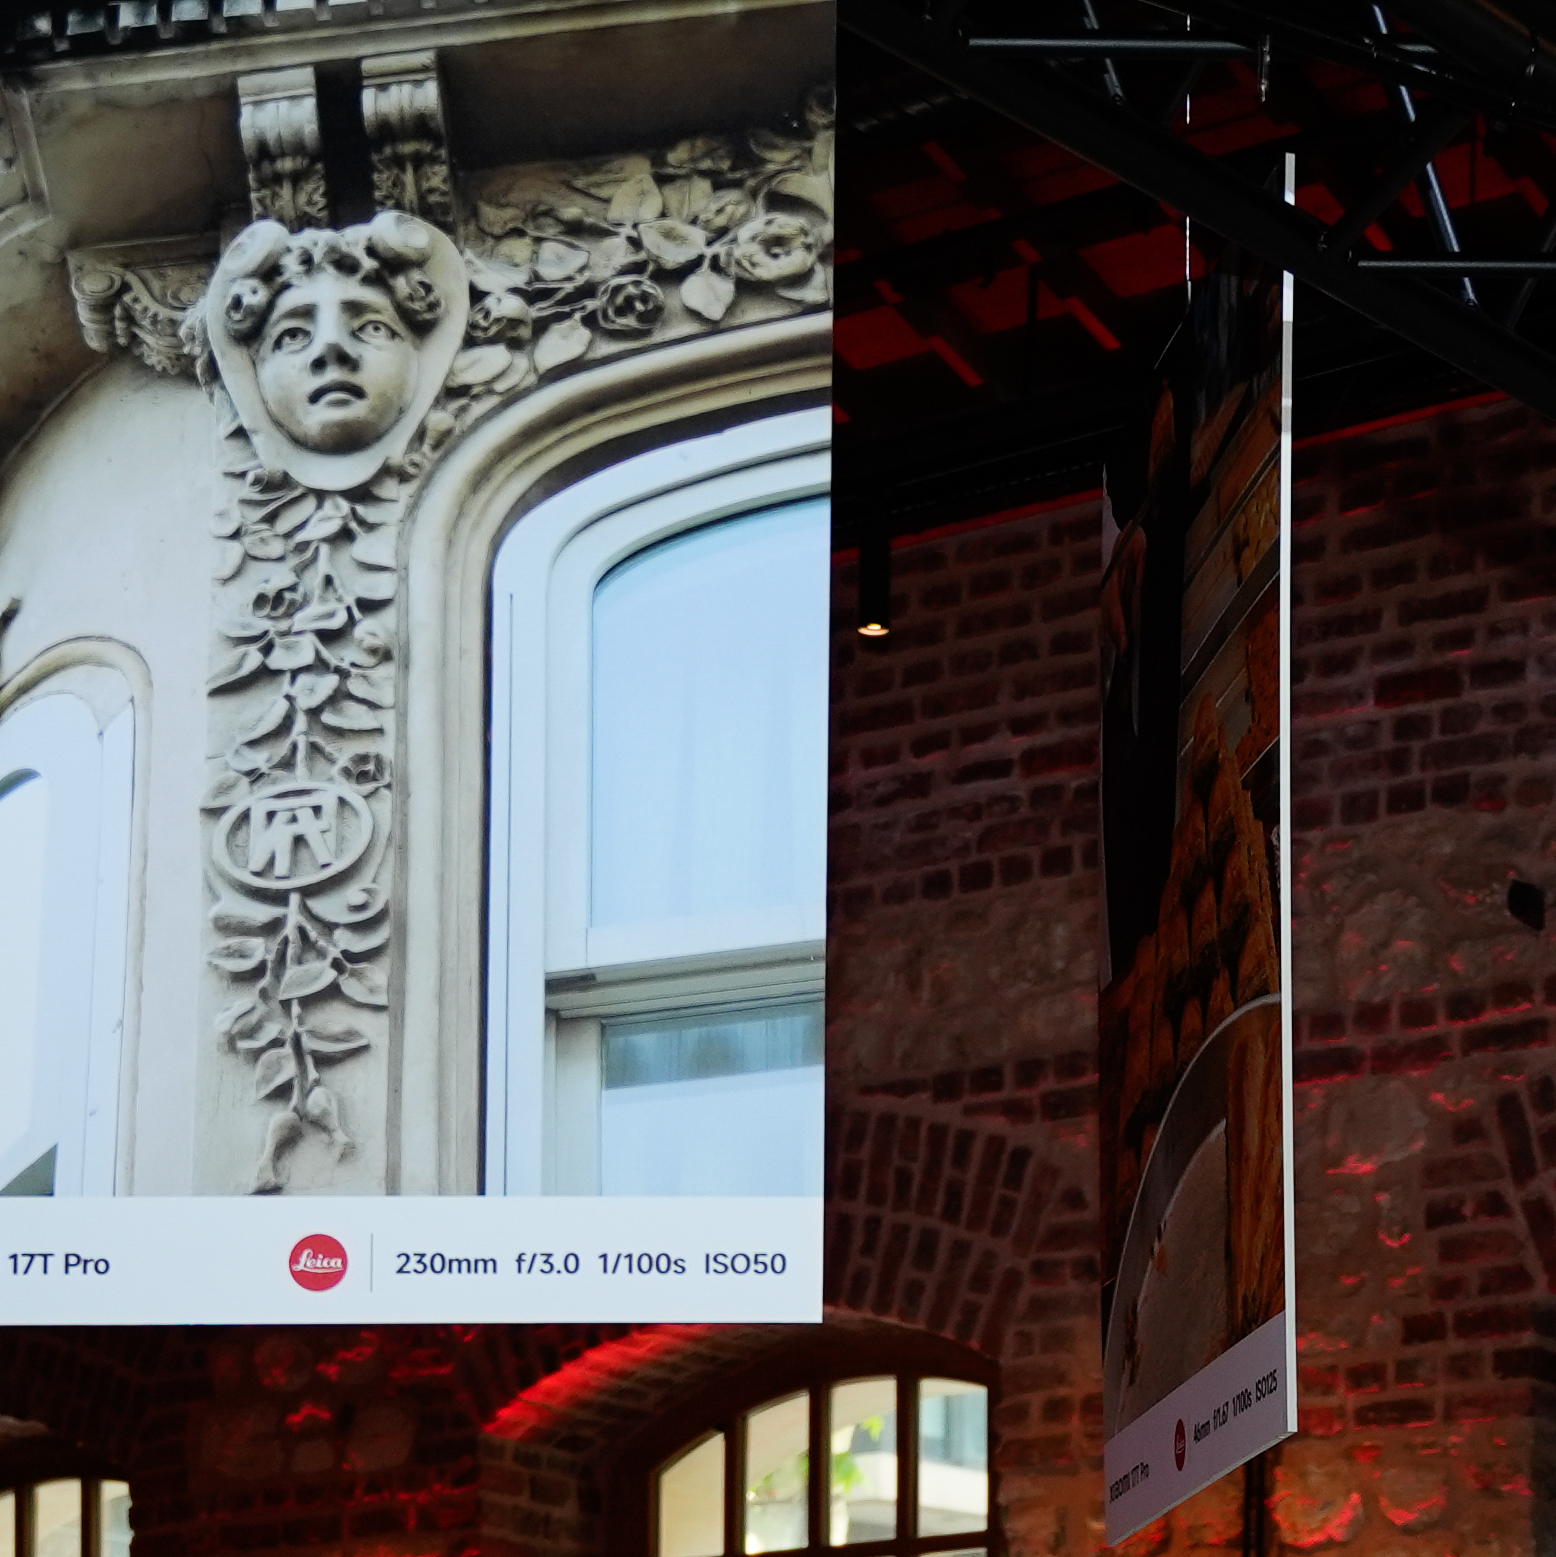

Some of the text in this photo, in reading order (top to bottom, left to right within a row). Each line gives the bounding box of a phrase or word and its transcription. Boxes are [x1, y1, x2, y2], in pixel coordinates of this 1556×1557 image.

[9, 1253, 54, 1274] 17T
[65, 1253, 110, 1275] Pro
[292, 1249, 343, 1273] Leica
[396, 1253, 787, 1275] 230mm f/3.0 1/100s ISO50
[1194, 1420, 1211, 1444] 46mm
[1232, 1388, 1252, 1417] 1/100s
[1255, 1369, 1278, 1403] ISO125
